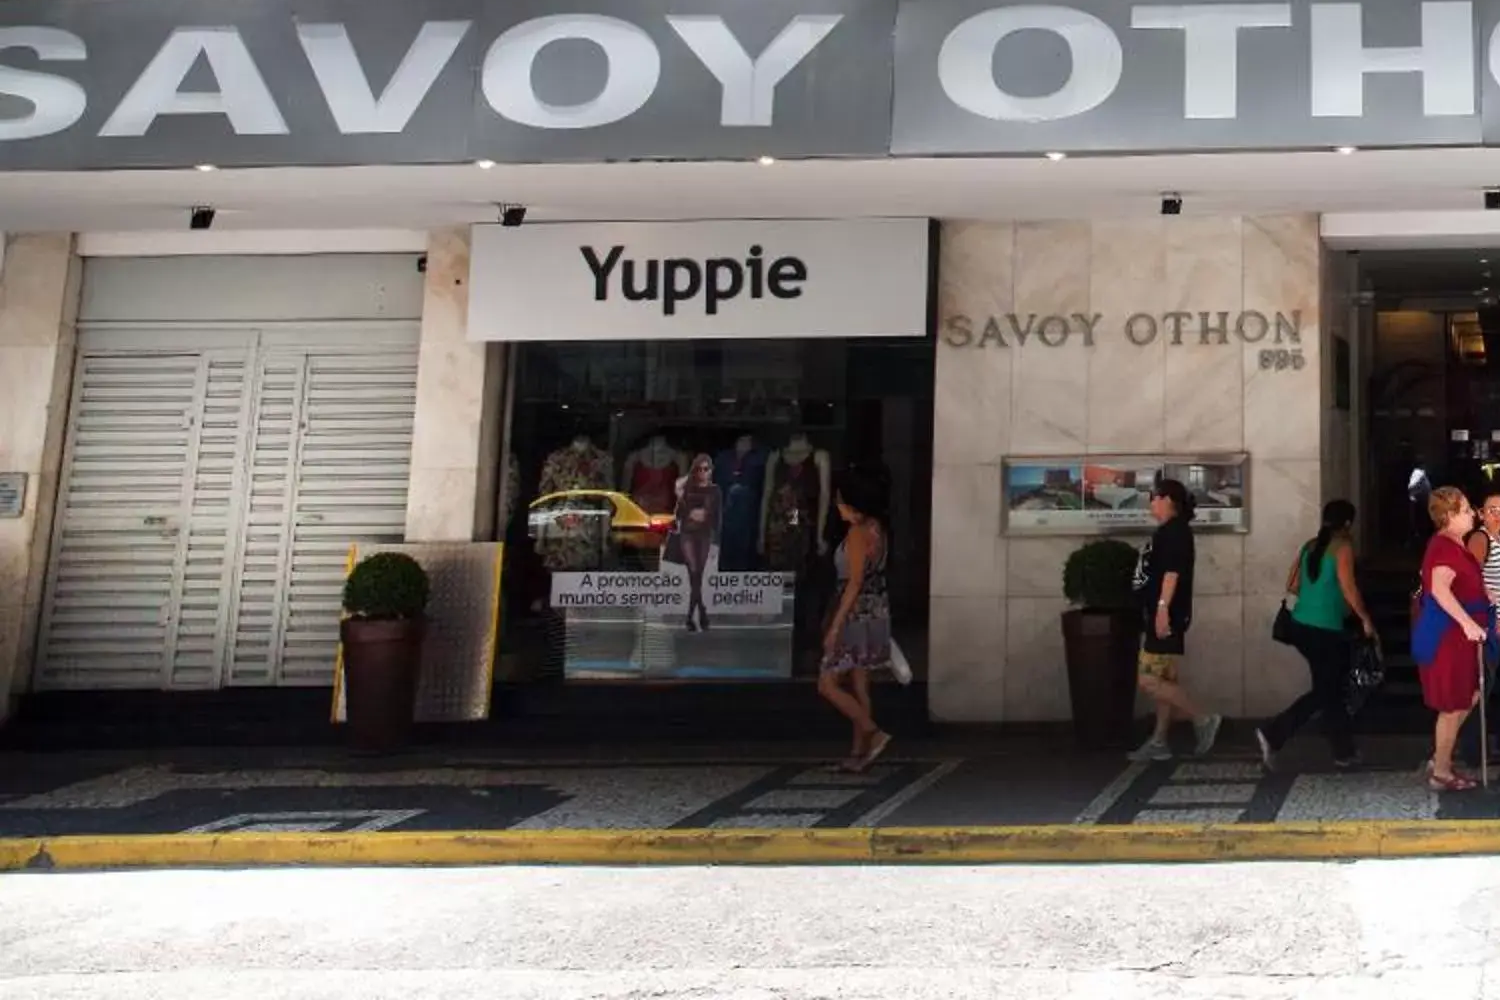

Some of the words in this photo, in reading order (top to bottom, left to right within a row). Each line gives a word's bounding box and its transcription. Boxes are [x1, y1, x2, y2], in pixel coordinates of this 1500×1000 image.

[0, 13, 844, 140] SAVOY
[579, 244, 807, 316] Yuppie
[944, 313, 1103, 348] SAVOY
[1124, 309, 1303, 346] OTHON
[559, 590, 616, 605] mundo
[621, 592, 682, 607] sempre
[581, 573, 593, 588] A
[597, 570, 682, 589] promoção
[707, 574, 739, 590] que
